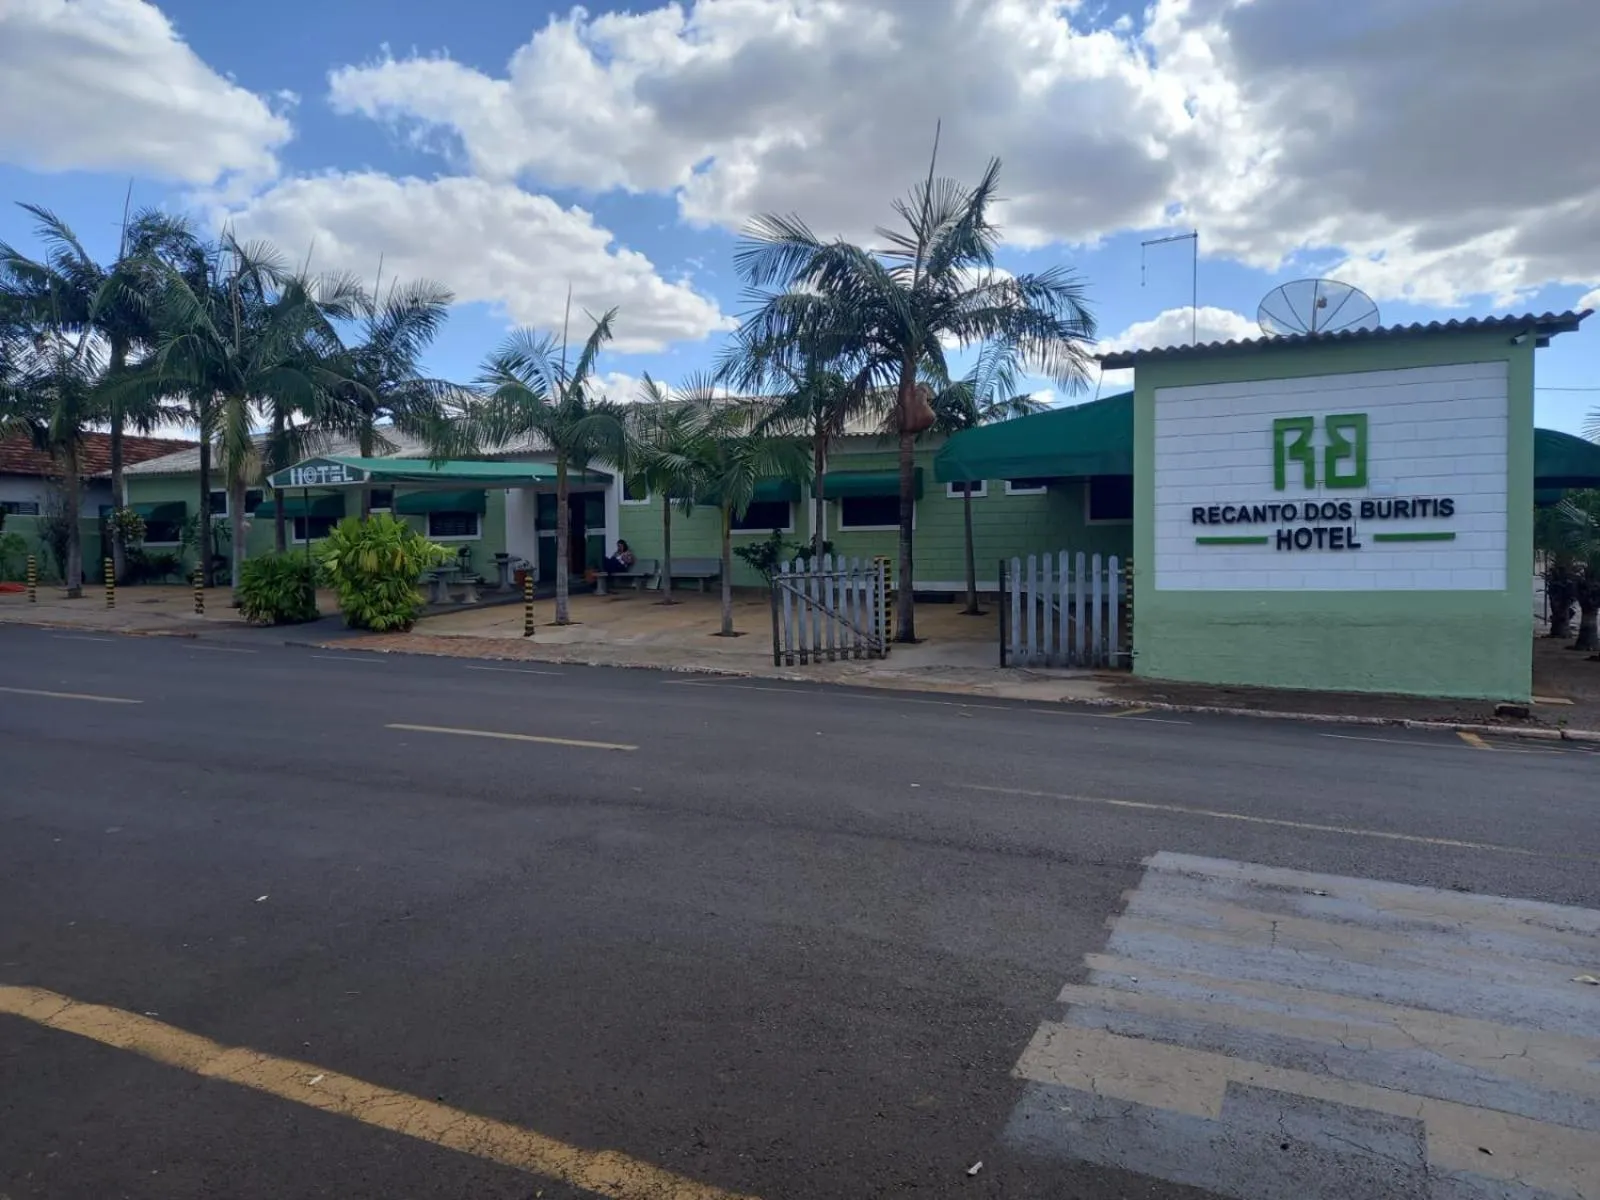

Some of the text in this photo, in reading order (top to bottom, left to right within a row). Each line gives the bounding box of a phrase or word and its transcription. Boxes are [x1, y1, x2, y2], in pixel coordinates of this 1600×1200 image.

[290, 465, 353, 486] HOTEL
[1192, 498, 1454, 524] RECANTO DOS BURITIS
[1276, 527, 1362, 551] HOTEL
